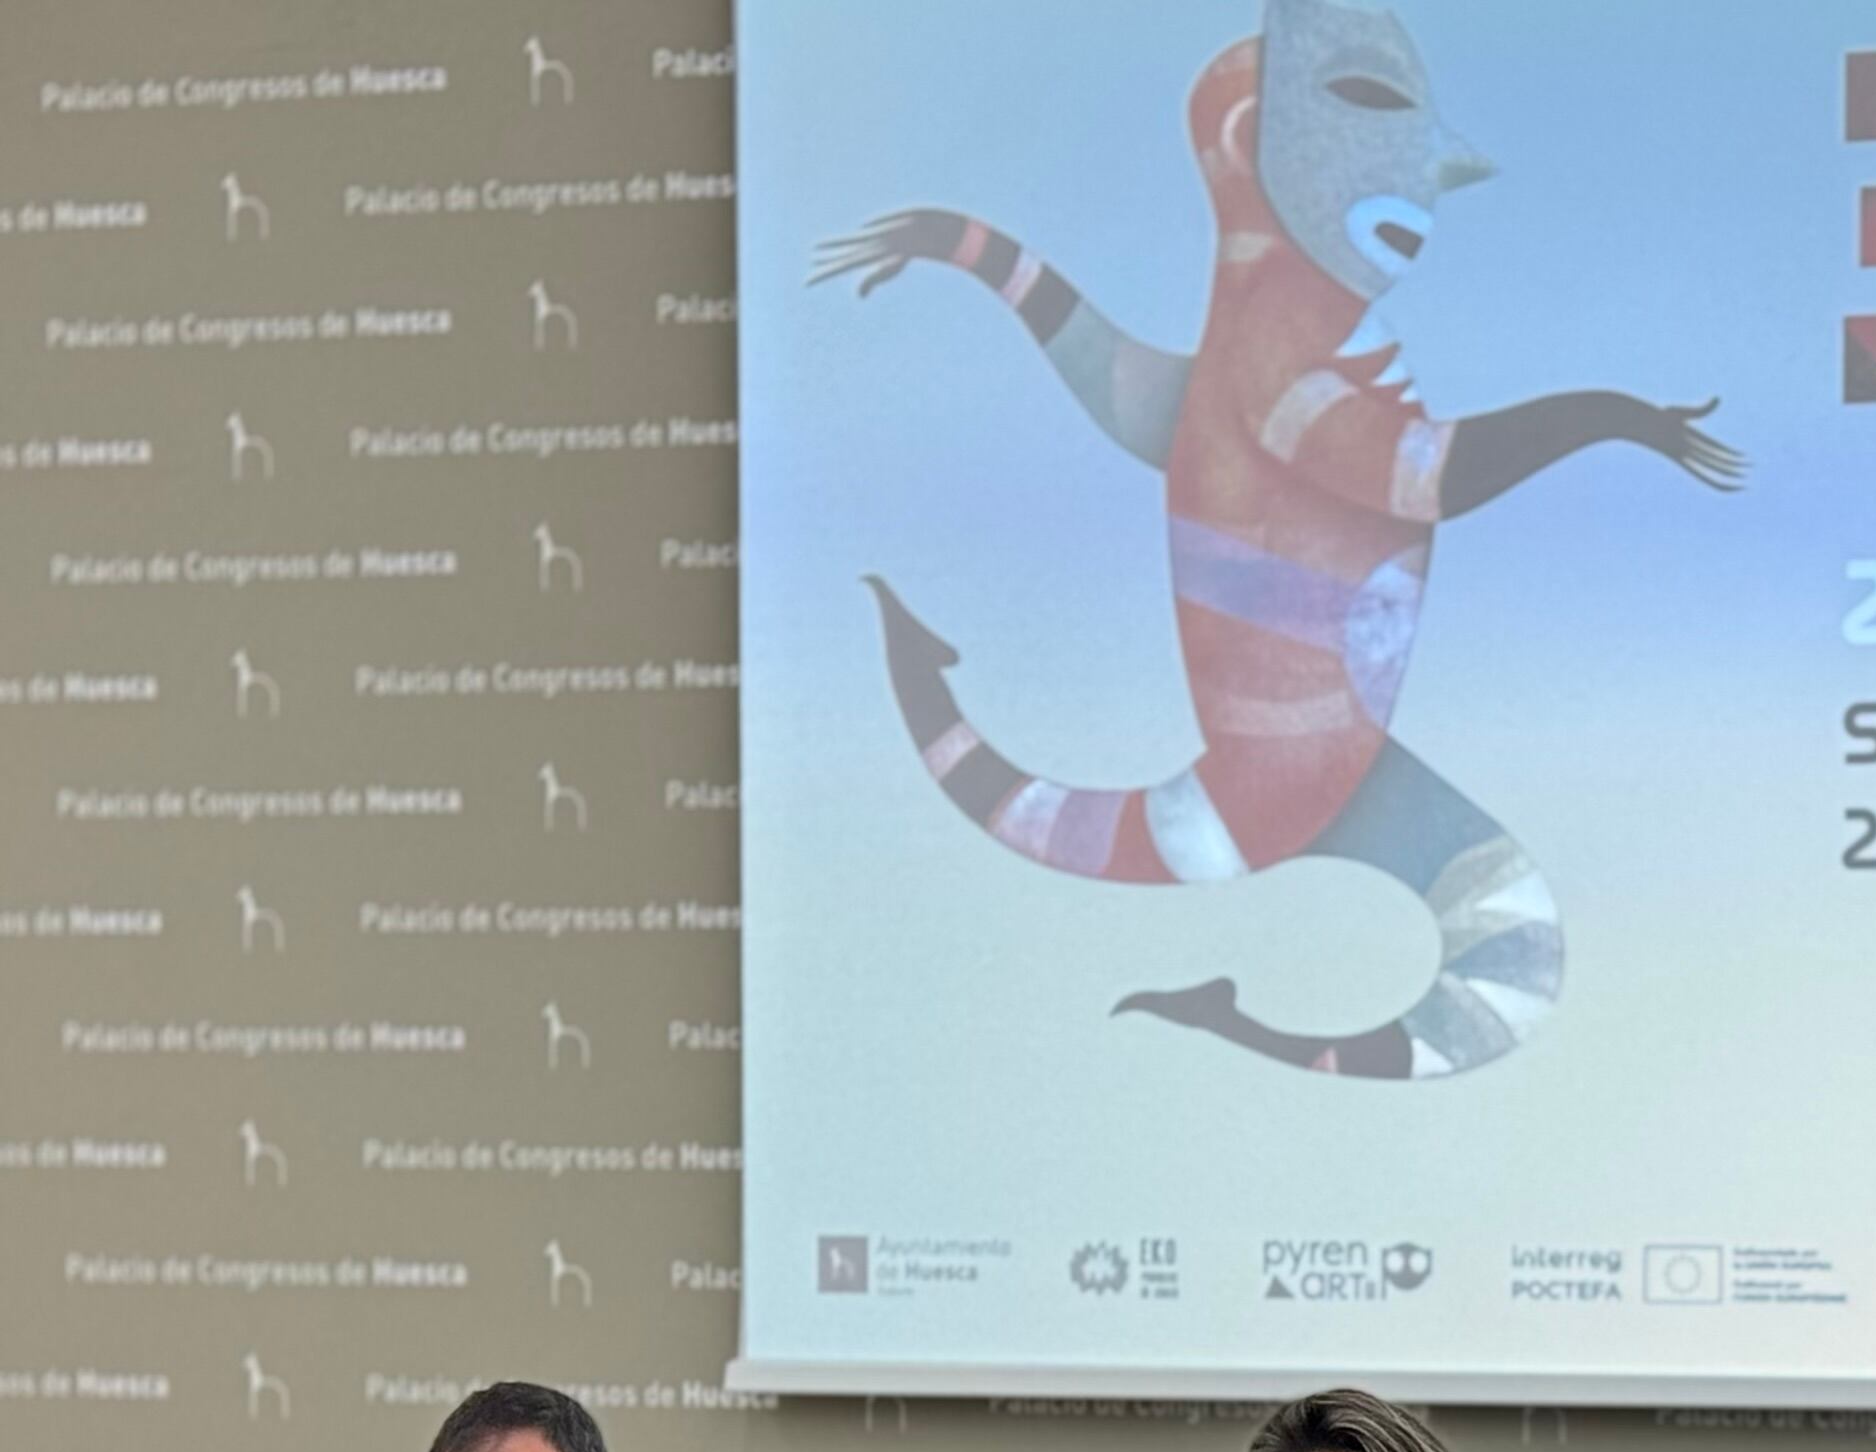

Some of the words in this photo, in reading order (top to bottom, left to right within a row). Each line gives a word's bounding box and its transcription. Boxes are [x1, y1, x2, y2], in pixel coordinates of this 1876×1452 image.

[42, 83, 132, 110] Palacio
[138, 81, 168, 106] de
[175, 76, 307, 108] Congresos
[313, 71, 344, 96] de
[351, 67, 446, 93] Huesca
[58, 790, 148, 818] Palacio
[154, 792, 184, 816] de
[190, 787, 323, 822] Congresos
[330, 789, 360, 814] de
[367, 787, 461, 812] Huesca
[62, 1021, 154, 1051] Palacio
[159, 1025, 189, 1050] de
[196, 1021, 327, 1056] Congresos
[334, 1024, 364, 1050] de
[371, 1024, 465, 1049] Huesca
[877, 1235, 1012, 1258] Ayuntamiento
[1140, 1238, 1176, 1265] EKO
[1263, 1240, 1369, 1274] pyren
[66, 1253, 156, 1282] Palacio
[162, 1259, 191, 1282] de
[197, 1255, 329, 1290] Congresos
[336, 1260, 366, 1285] de
[373, 1259, 467, 1285] Huesca
[876, 1263, 899, 1282] de
[905, 1263, 978, 1282] Huesca
[1512, 1280, 1621, 1301] POCTEFA
